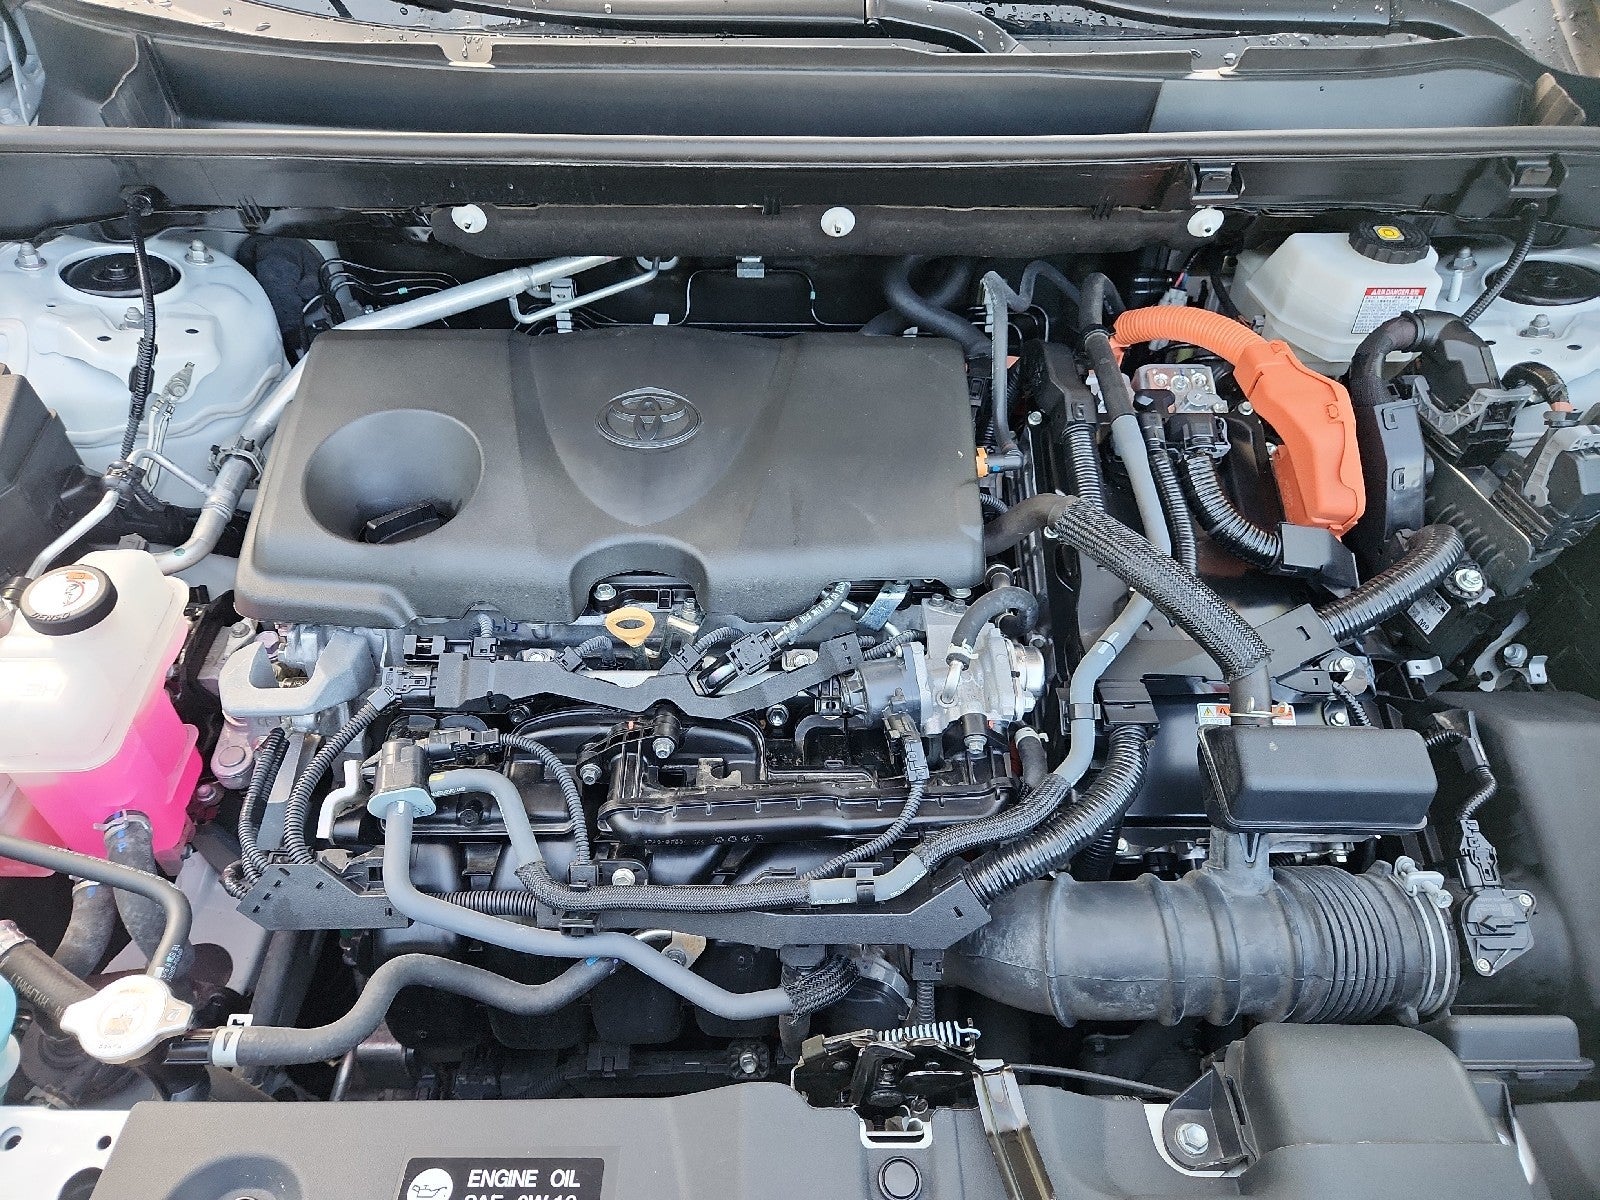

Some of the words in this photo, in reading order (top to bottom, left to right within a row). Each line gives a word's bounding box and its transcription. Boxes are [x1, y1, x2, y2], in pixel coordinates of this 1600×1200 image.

[30, 612, 71, 622] DENSO
[467, 1168, 539, 1188] ENGINE
[550, 1168, 581, 1188] OIL
